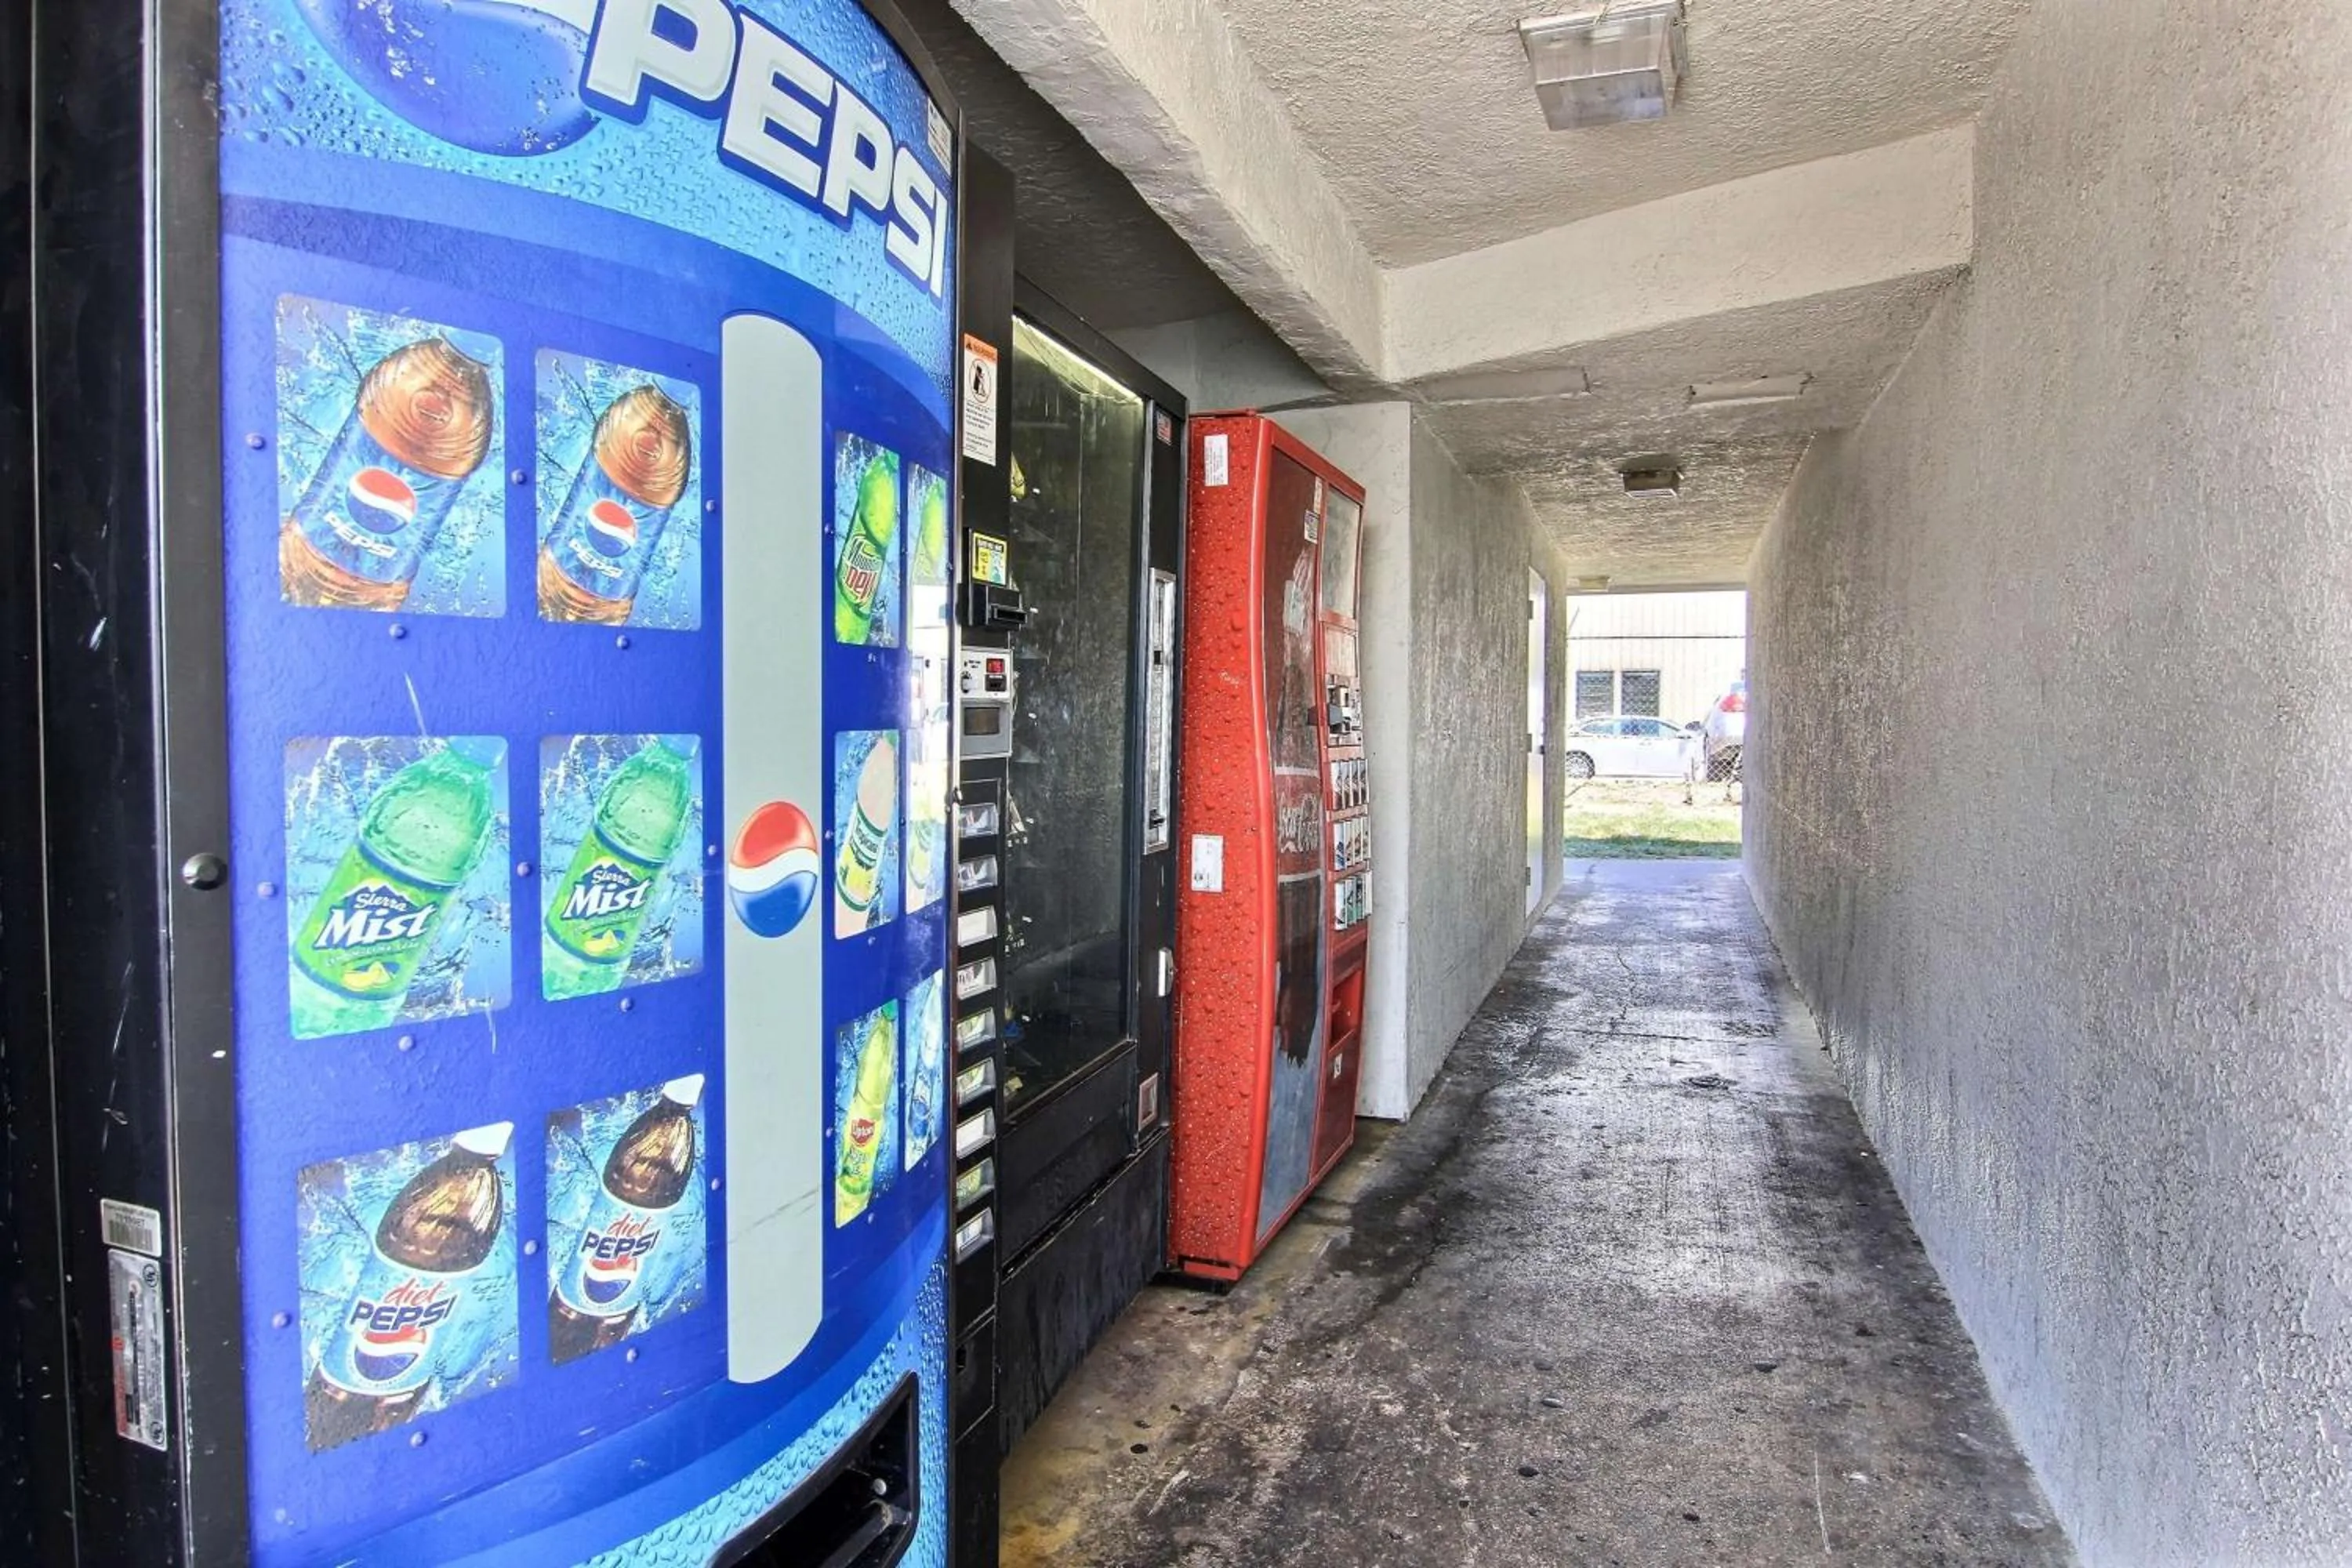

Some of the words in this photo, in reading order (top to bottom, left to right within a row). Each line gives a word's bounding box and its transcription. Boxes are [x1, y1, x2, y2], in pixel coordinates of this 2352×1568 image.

[586, 0, 947, 299] PEPSI
[323, 510, 397, 559] PEPSI
[568, 538, 625, 579] PEPSI
[354, 893, 407, 912] Sierra
[561, 878, 653, 918] Mist
[314, 904, 437, 948] Mist
[581, 1229, 661, 1258] PEPSI
[607, 1213, 651, 1237] diet
[383, 1277, 444, 1306] diet
[350, 1294, 459, 1330] PEPSI
